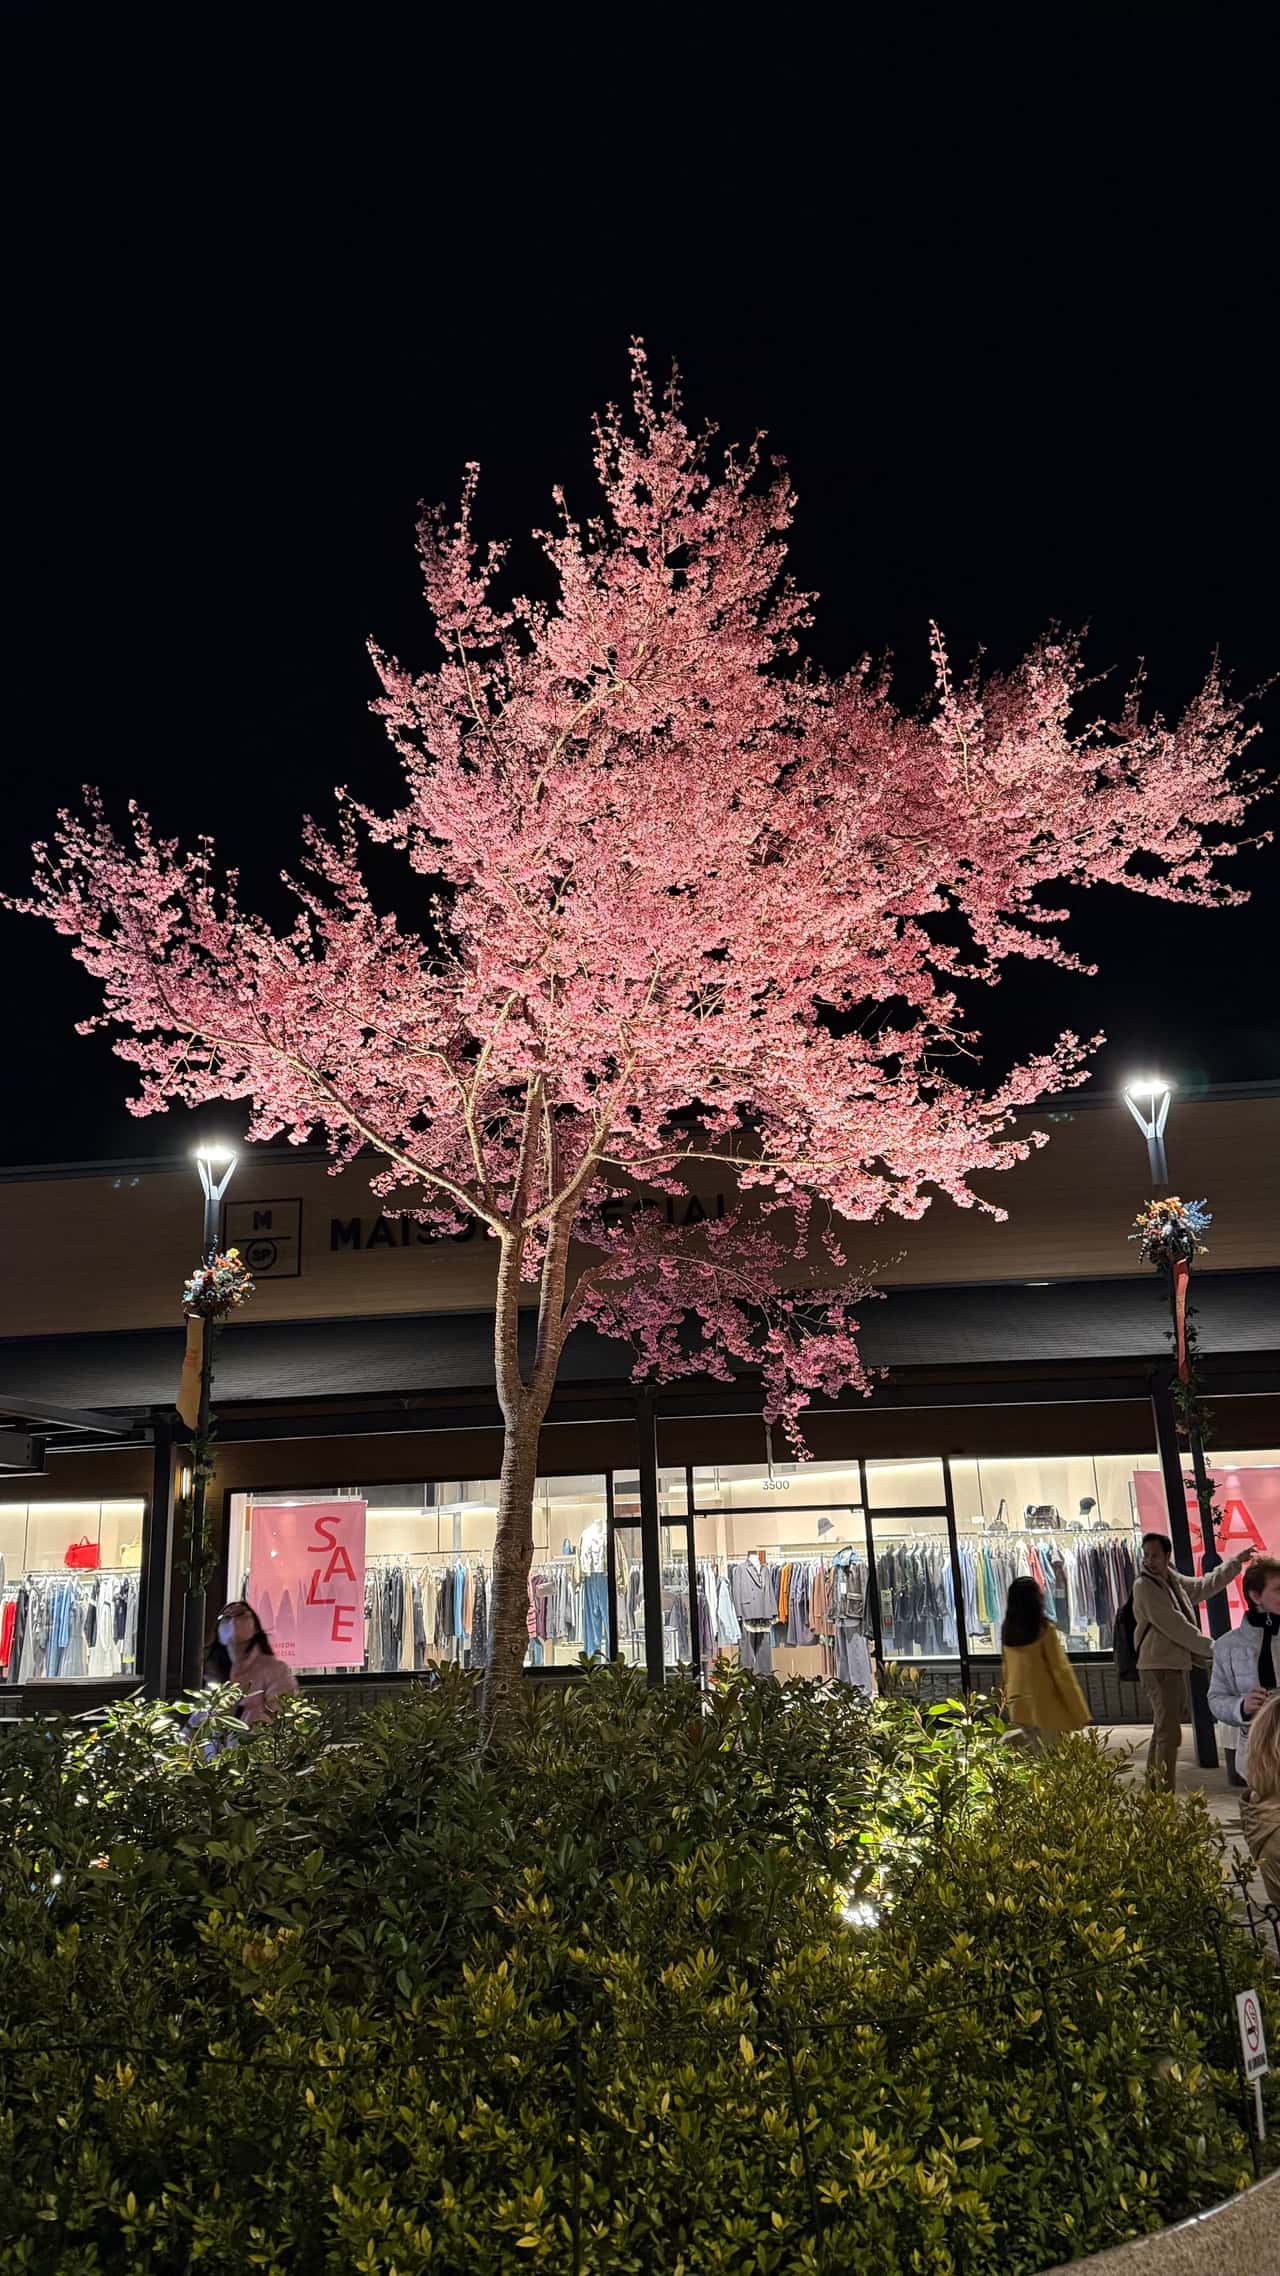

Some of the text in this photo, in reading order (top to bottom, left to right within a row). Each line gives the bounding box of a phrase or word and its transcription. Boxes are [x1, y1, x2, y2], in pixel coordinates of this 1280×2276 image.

[253, 1210, 271, 1230] M
[763, 1480, 790, 1490] 3500
[306, 1516, 357, 1642] SALE
